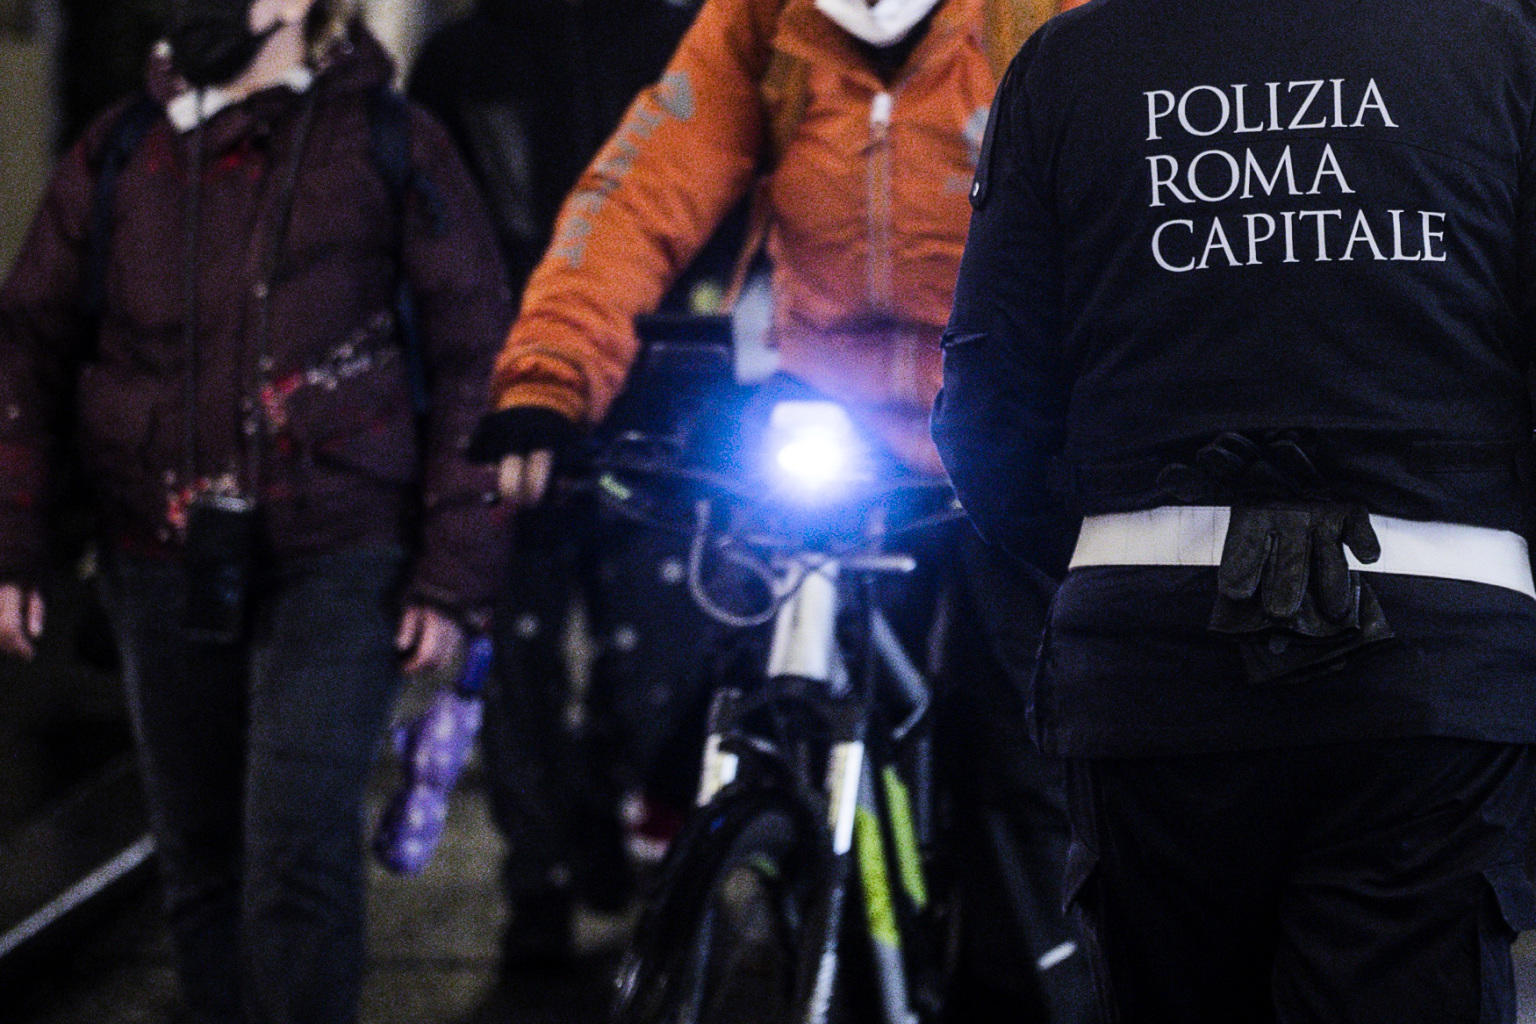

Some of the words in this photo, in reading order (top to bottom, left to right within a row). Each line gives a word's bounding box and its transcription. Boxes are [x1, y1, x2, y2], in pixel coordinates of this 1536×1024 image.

[1143, 77, 1400, 141] POLIZIA
[1145, 143, 1356, 207] ROMA
[1151, 208, 1448, 272] CAPITALE
